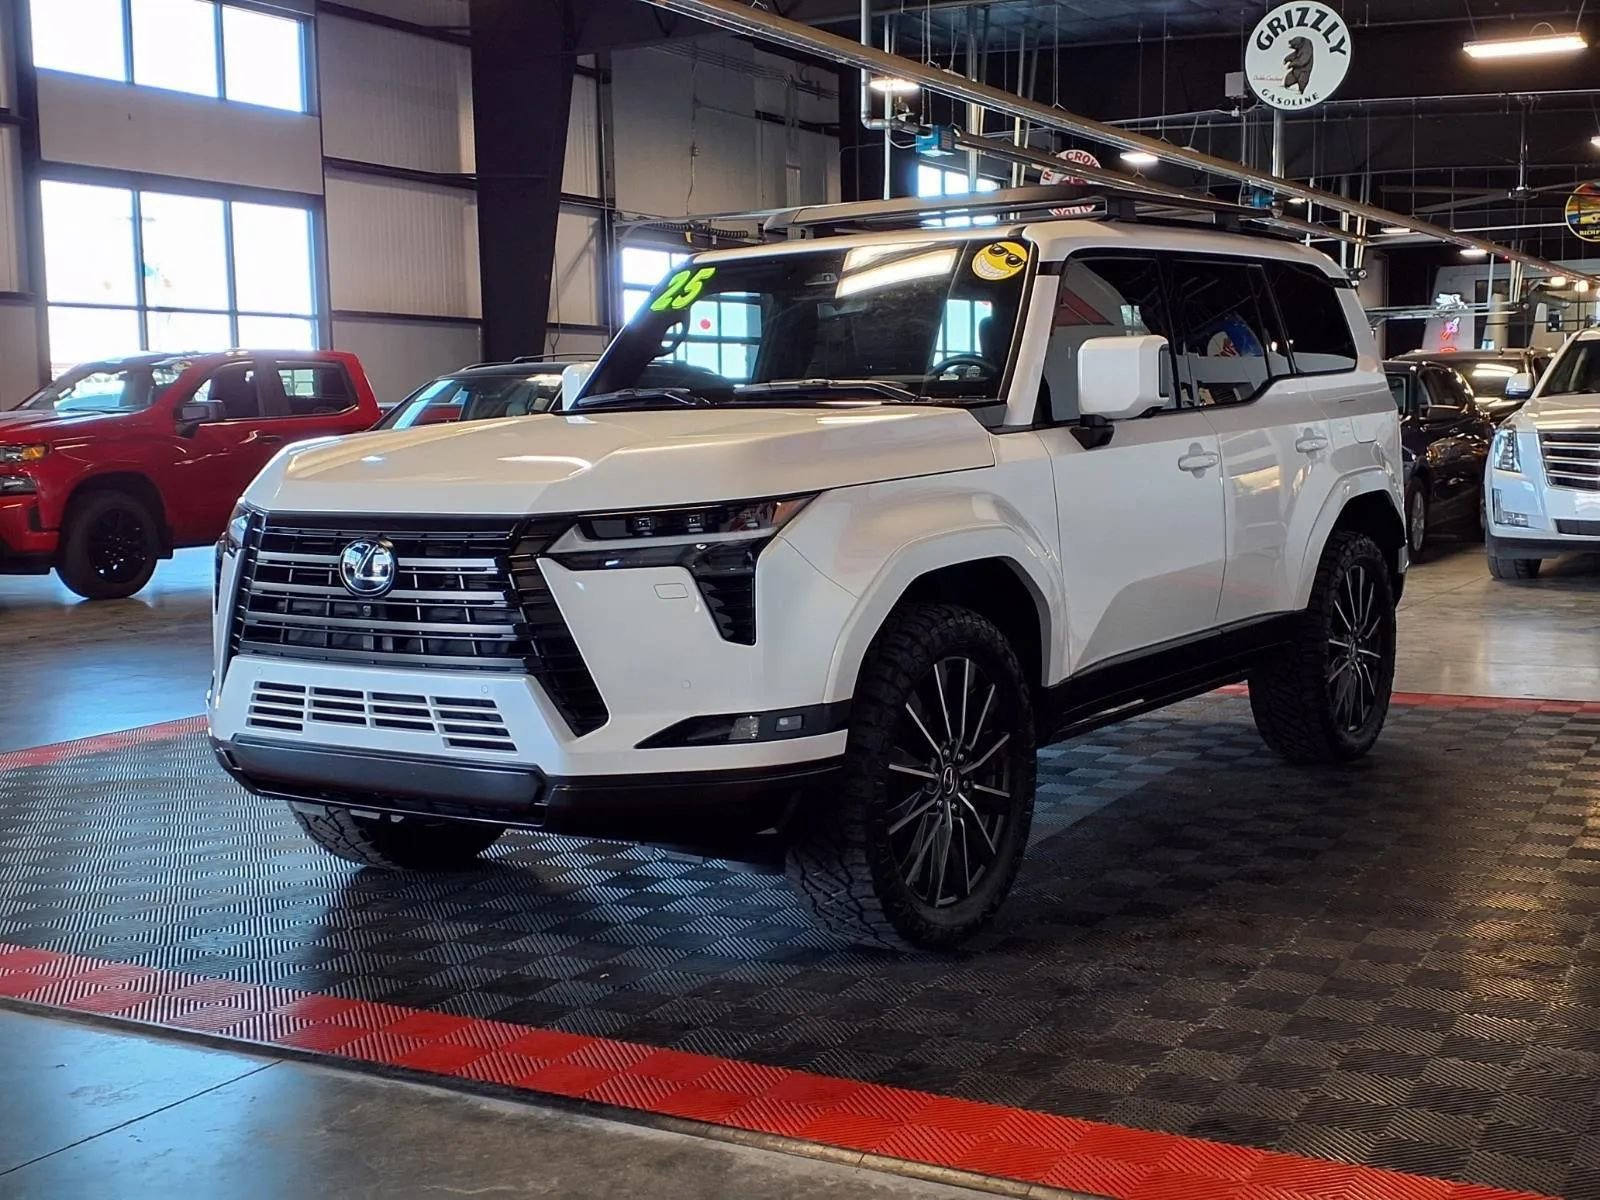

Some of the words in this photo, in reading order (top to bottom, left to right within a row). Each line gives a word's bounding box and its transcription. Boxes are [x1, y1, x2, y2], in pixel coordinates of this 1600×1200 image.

[1256, 7, 1346, 55] GRIZZLY
[1261, 88, 1320, 106] GASOLINE
[649, 267, 716, 311] 25
